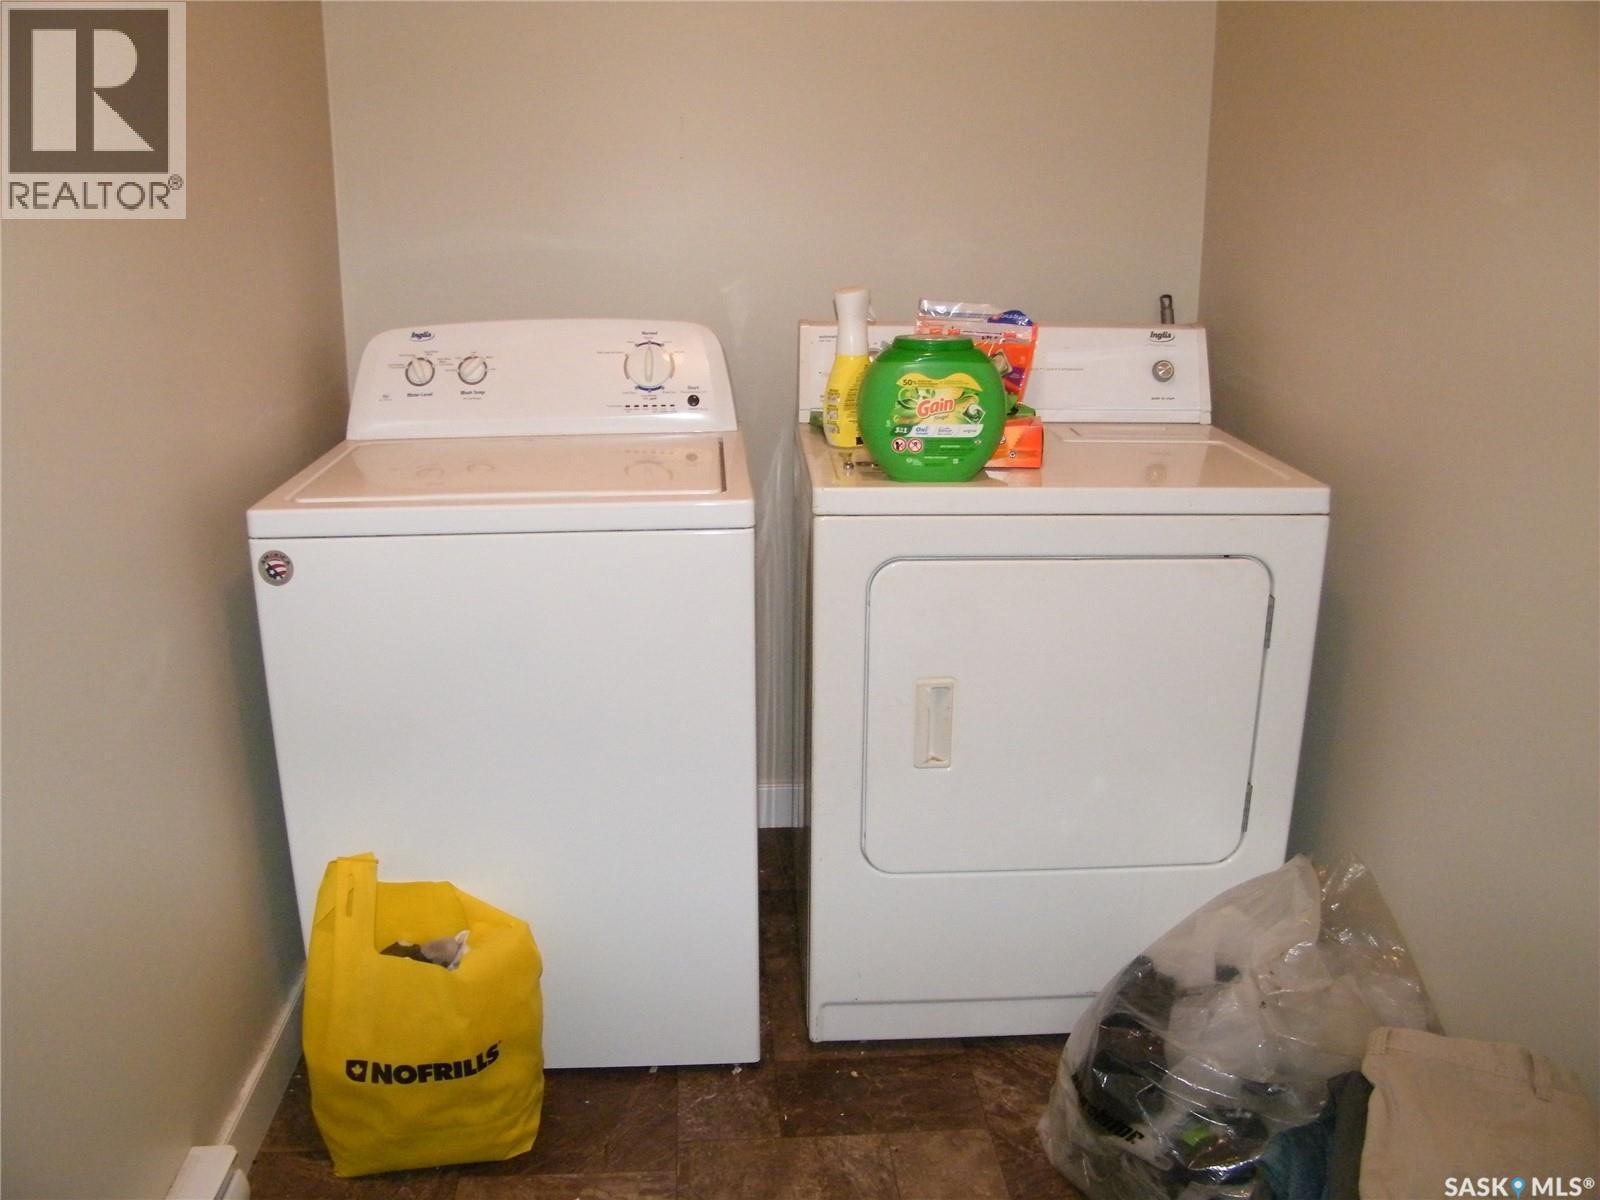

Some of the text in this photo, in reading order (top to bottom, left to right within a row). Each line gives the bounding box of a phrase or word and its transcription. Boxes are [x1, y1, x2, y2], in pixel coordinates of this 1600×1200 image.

[410, 331, 432, 340] Inglis
[1150, 331, 1172, 340] Inglis
[917, 398, 955, 418] Gain
[371, 1042, 500, 1085] NOFRILLS
